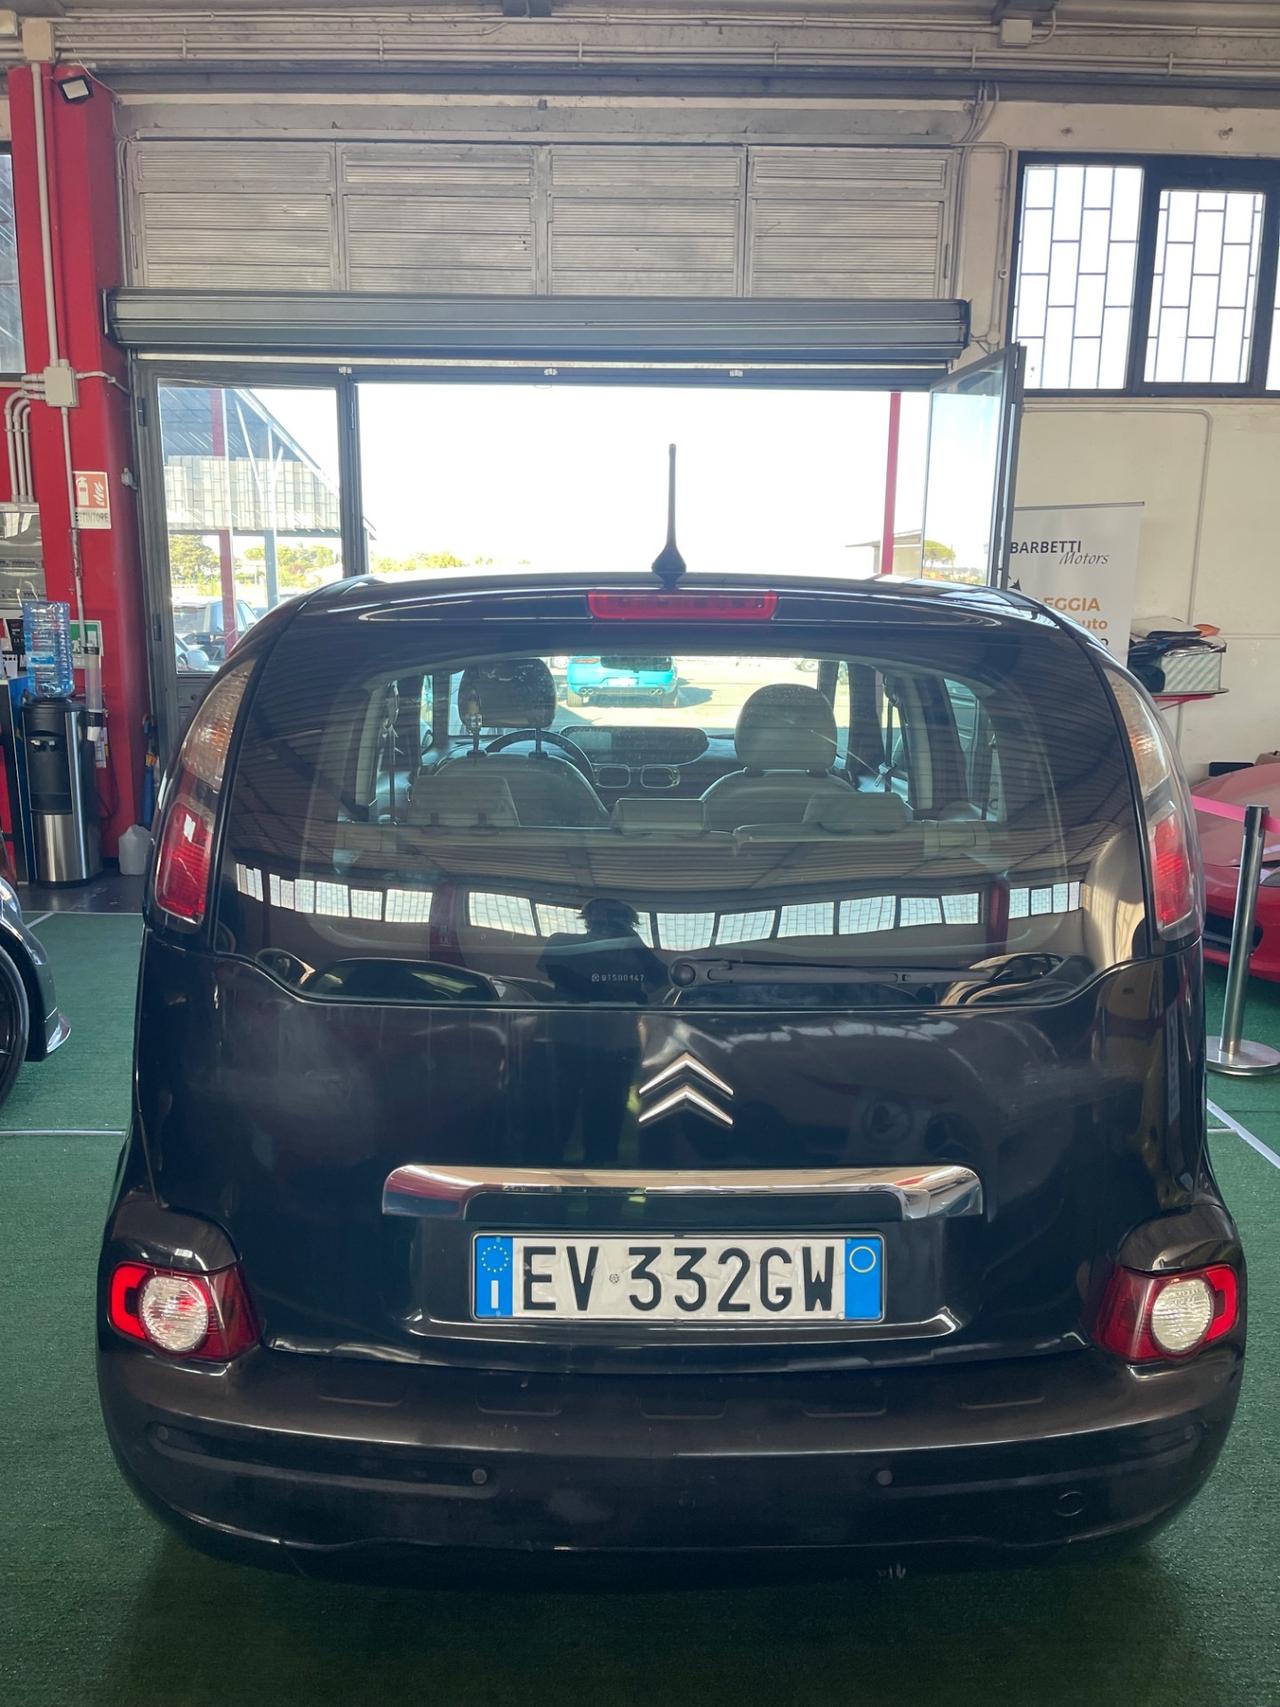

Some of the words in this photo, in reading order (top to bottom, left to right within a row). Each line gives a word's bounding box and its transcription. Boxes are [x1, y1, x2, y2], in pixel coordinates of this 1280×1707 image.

[1010, 540, 1082, 554] BARBETTI
[1059, 551, 1110, 565] Motors
[1043, 597, 1100, 611] EGGIA
[1082, 618, 1108, 630] uto
[491, 1279, 499, 1309] I
[523, 1246, 599, 1311] EV
[628, 1246, 834, 1312] 332GW
